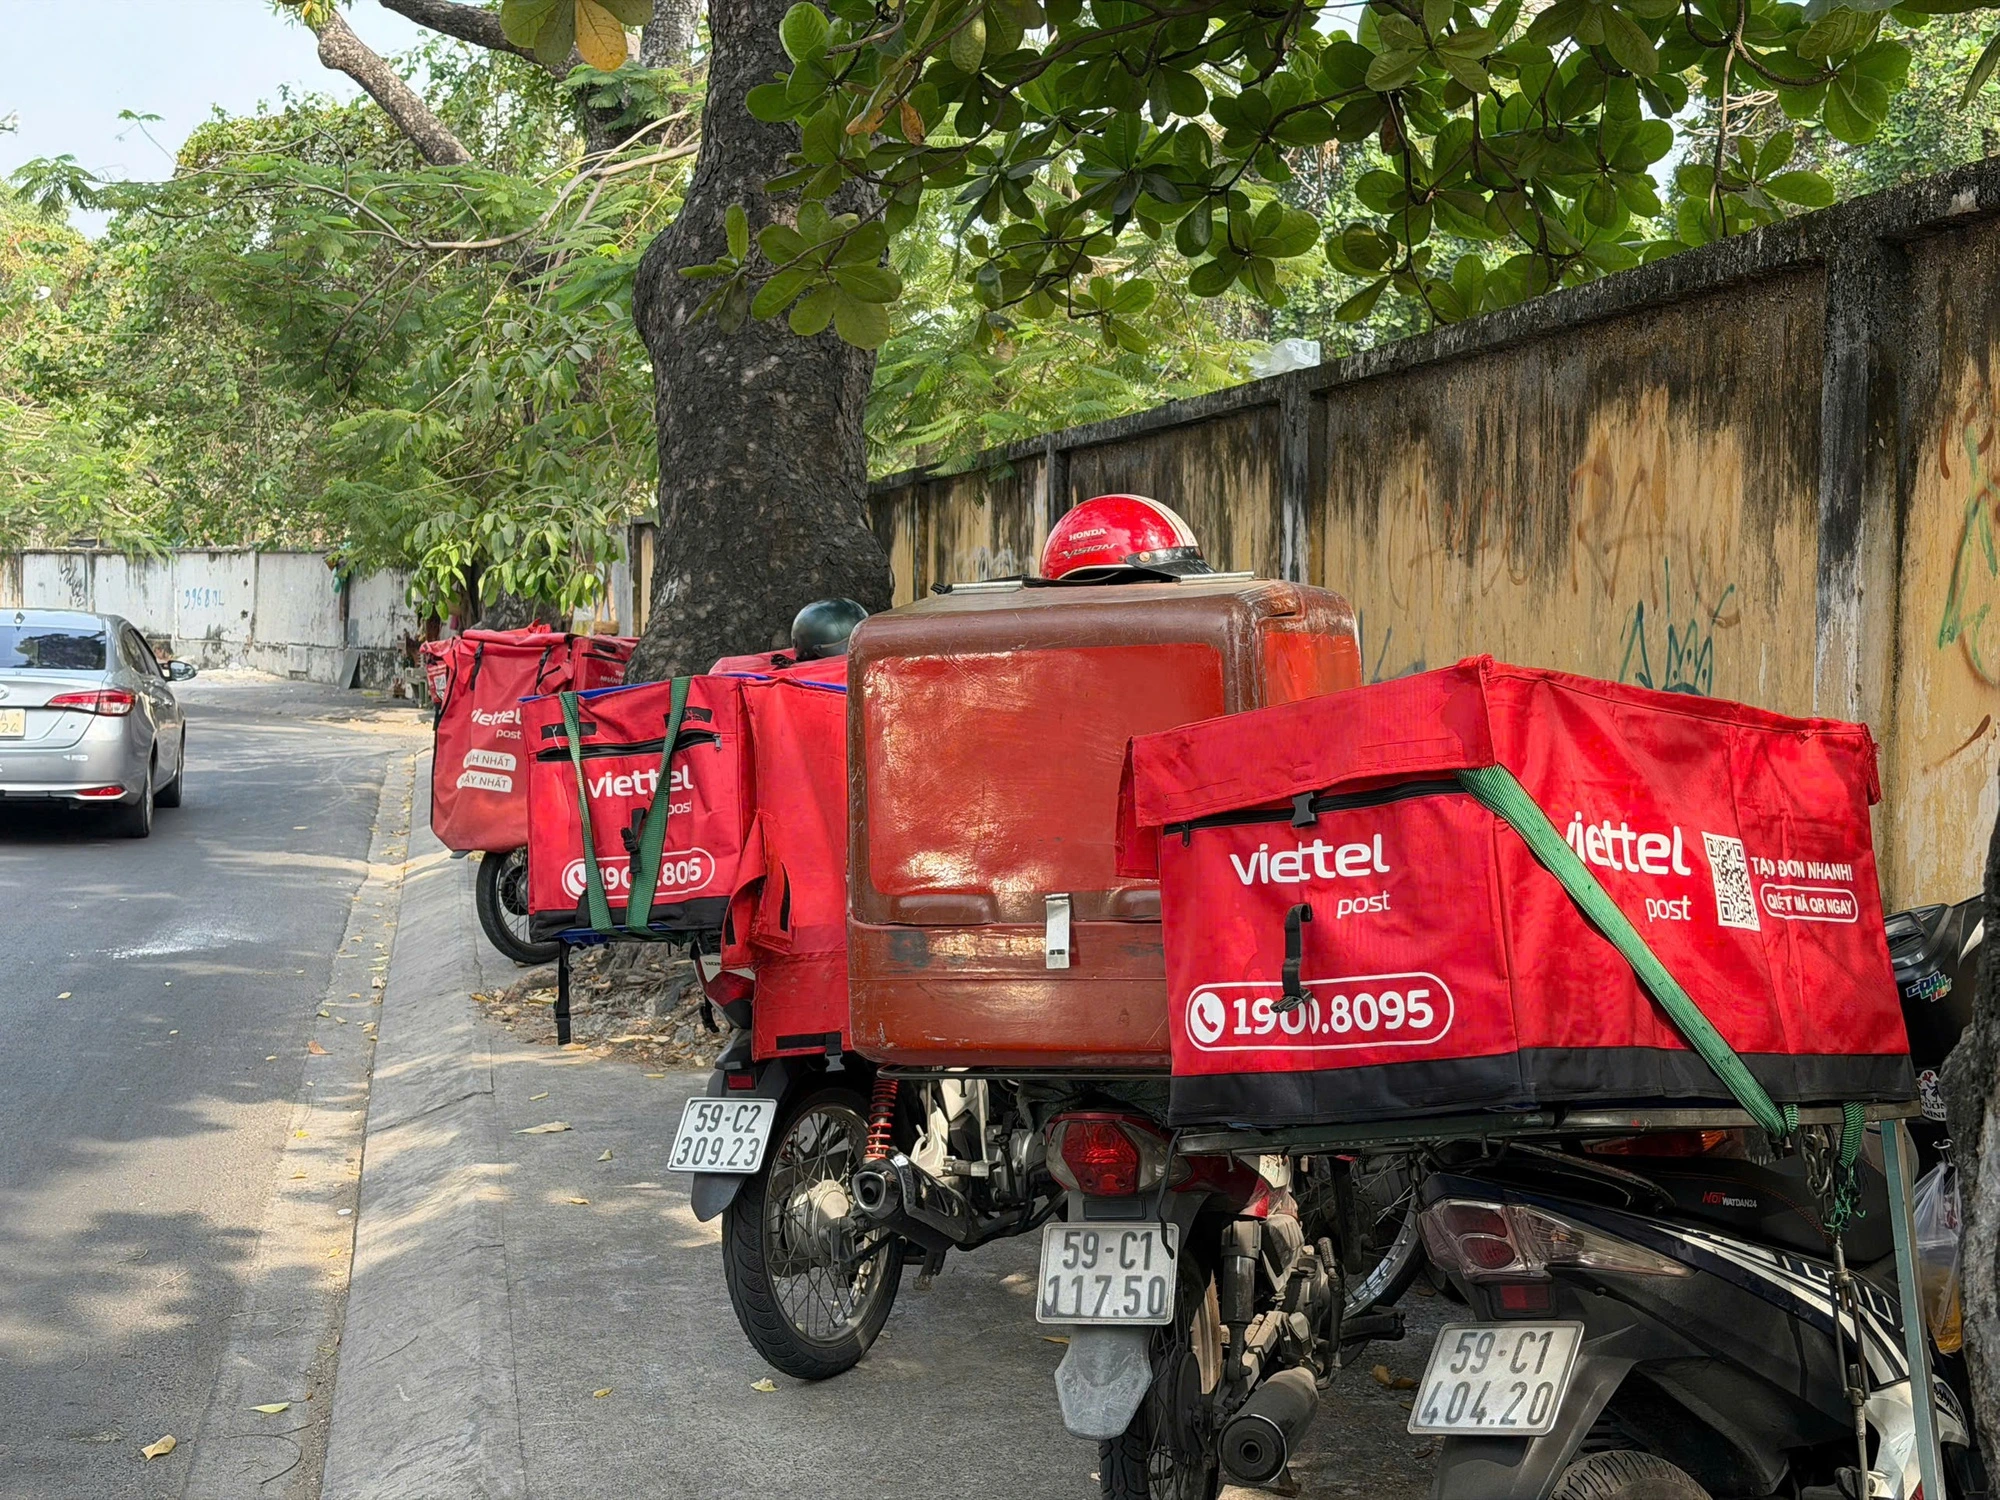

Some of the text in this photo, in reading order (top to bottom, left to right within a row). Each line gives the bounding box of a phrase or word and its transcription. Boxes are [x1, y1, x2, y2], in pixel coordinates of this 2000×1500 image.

[1069, 528, 1108, 541] HONDA
[496, 729, 521, 740] post
[482, 755, 510, 767] NHẤT
[479, 776, 508, 788] NHẤT
[1229, 834, 1390, 885] viettel
[1807, 861, 1853, 882] NHANH!
[1336, 890, 1391, 919] post
[1645, 895, 1692, 922] post
[1810, 897, 1825, 914] QR
[1826, 899, 1853, 915] NGAY
[694, 1104, 762, 1133] 59-C2
[676, 1137, 760, 1166] 309.23
[1062, 1231, 1153, 1271] 59-C1
[1048, 1275, 1166, 1316] 117.50
[1421, 1380, 1554, 1426] 404.20
